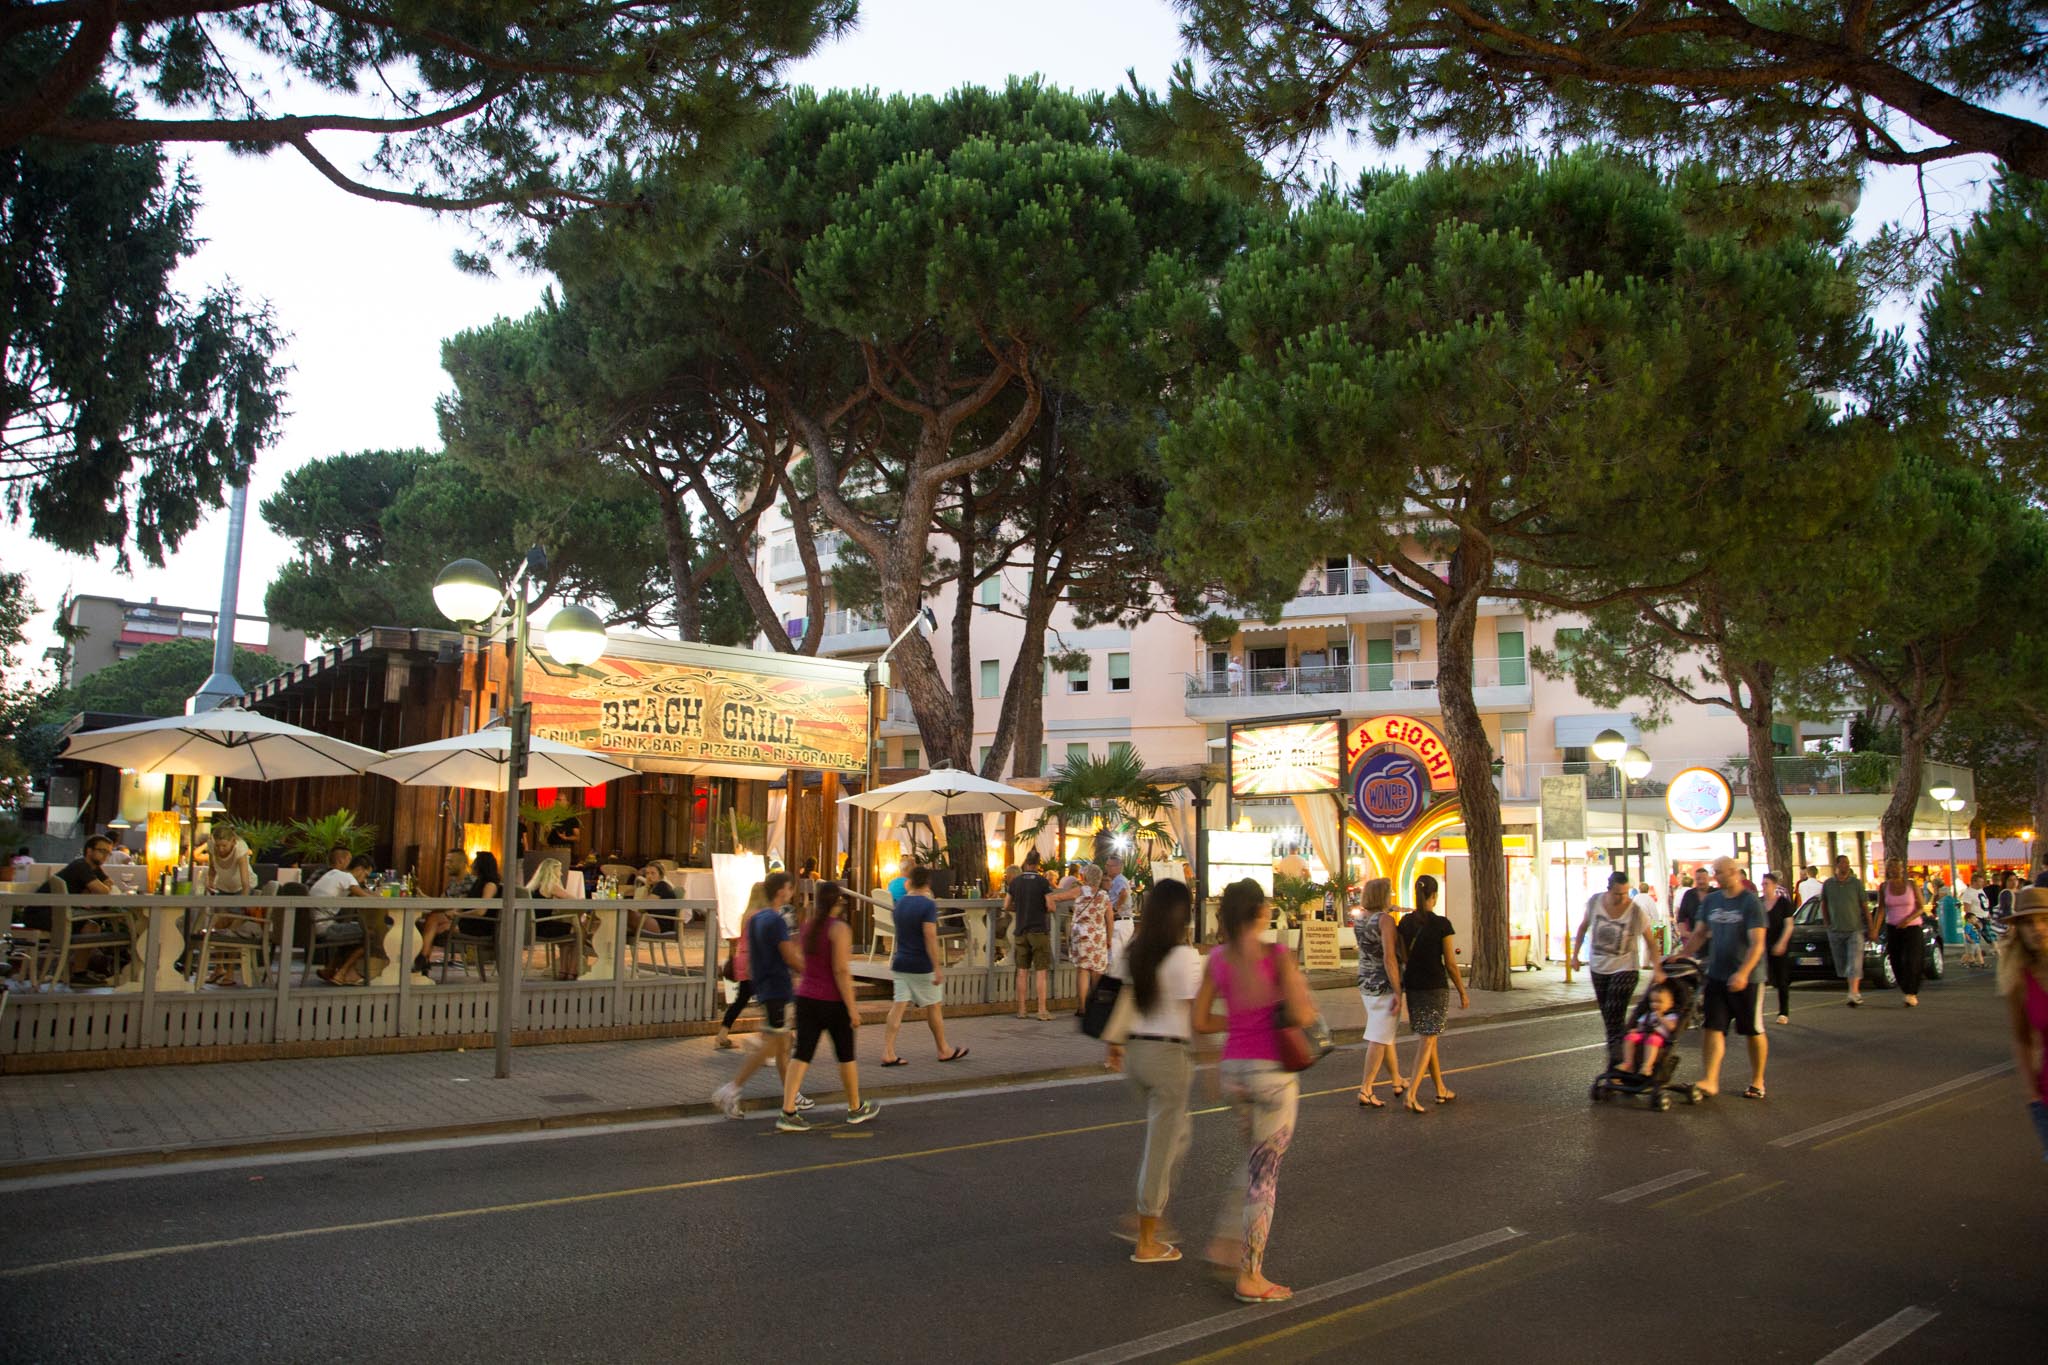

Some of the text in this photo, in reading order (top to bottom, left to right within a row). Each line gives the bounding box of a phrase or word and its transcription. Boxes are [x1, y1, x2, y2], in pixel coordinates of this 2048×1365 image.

[602, 697, 799, 745] BEACH GRILL
[602, 733, 650, 750] DRINK
[652, 738, 682, 753] BAR
[700, 743, 761, 760] PIZZERIA
[773, 748, 851, 766] RISTORANTE
[1384, 719, 1451, 780] GIOCHI
